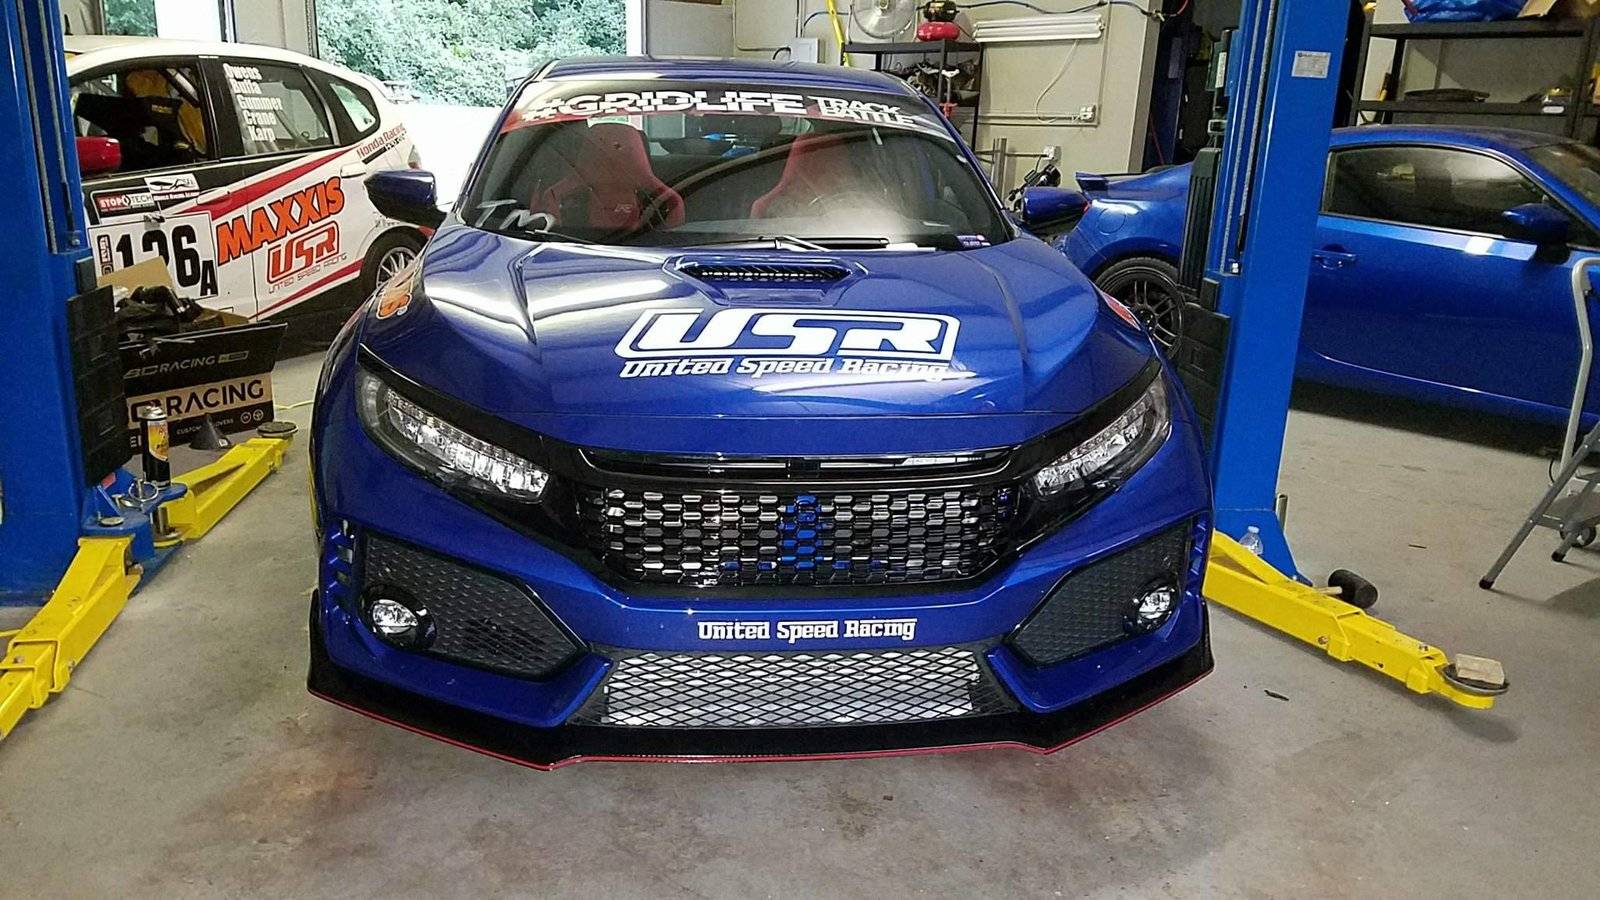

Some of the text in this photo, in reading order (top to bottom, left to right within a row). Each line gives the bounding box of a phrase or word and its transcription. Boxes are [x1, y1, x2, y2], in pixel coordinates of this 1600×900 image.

[522, 91, 901, 122] #GRIDLIFE TRACK
[819, 108, 916, 128] BATTLE
[356, 136, 384, 159] Honda
[215, 175, 345, 267] MAXXIS
[267, 220, 340, 284] USR
[615, 308, 961, 361] USR
[619, 357, 951, 382] United Speed Racing
[165, 379, 264, 417] RACING
[697, 617, 918, 644] United Speed Racing
